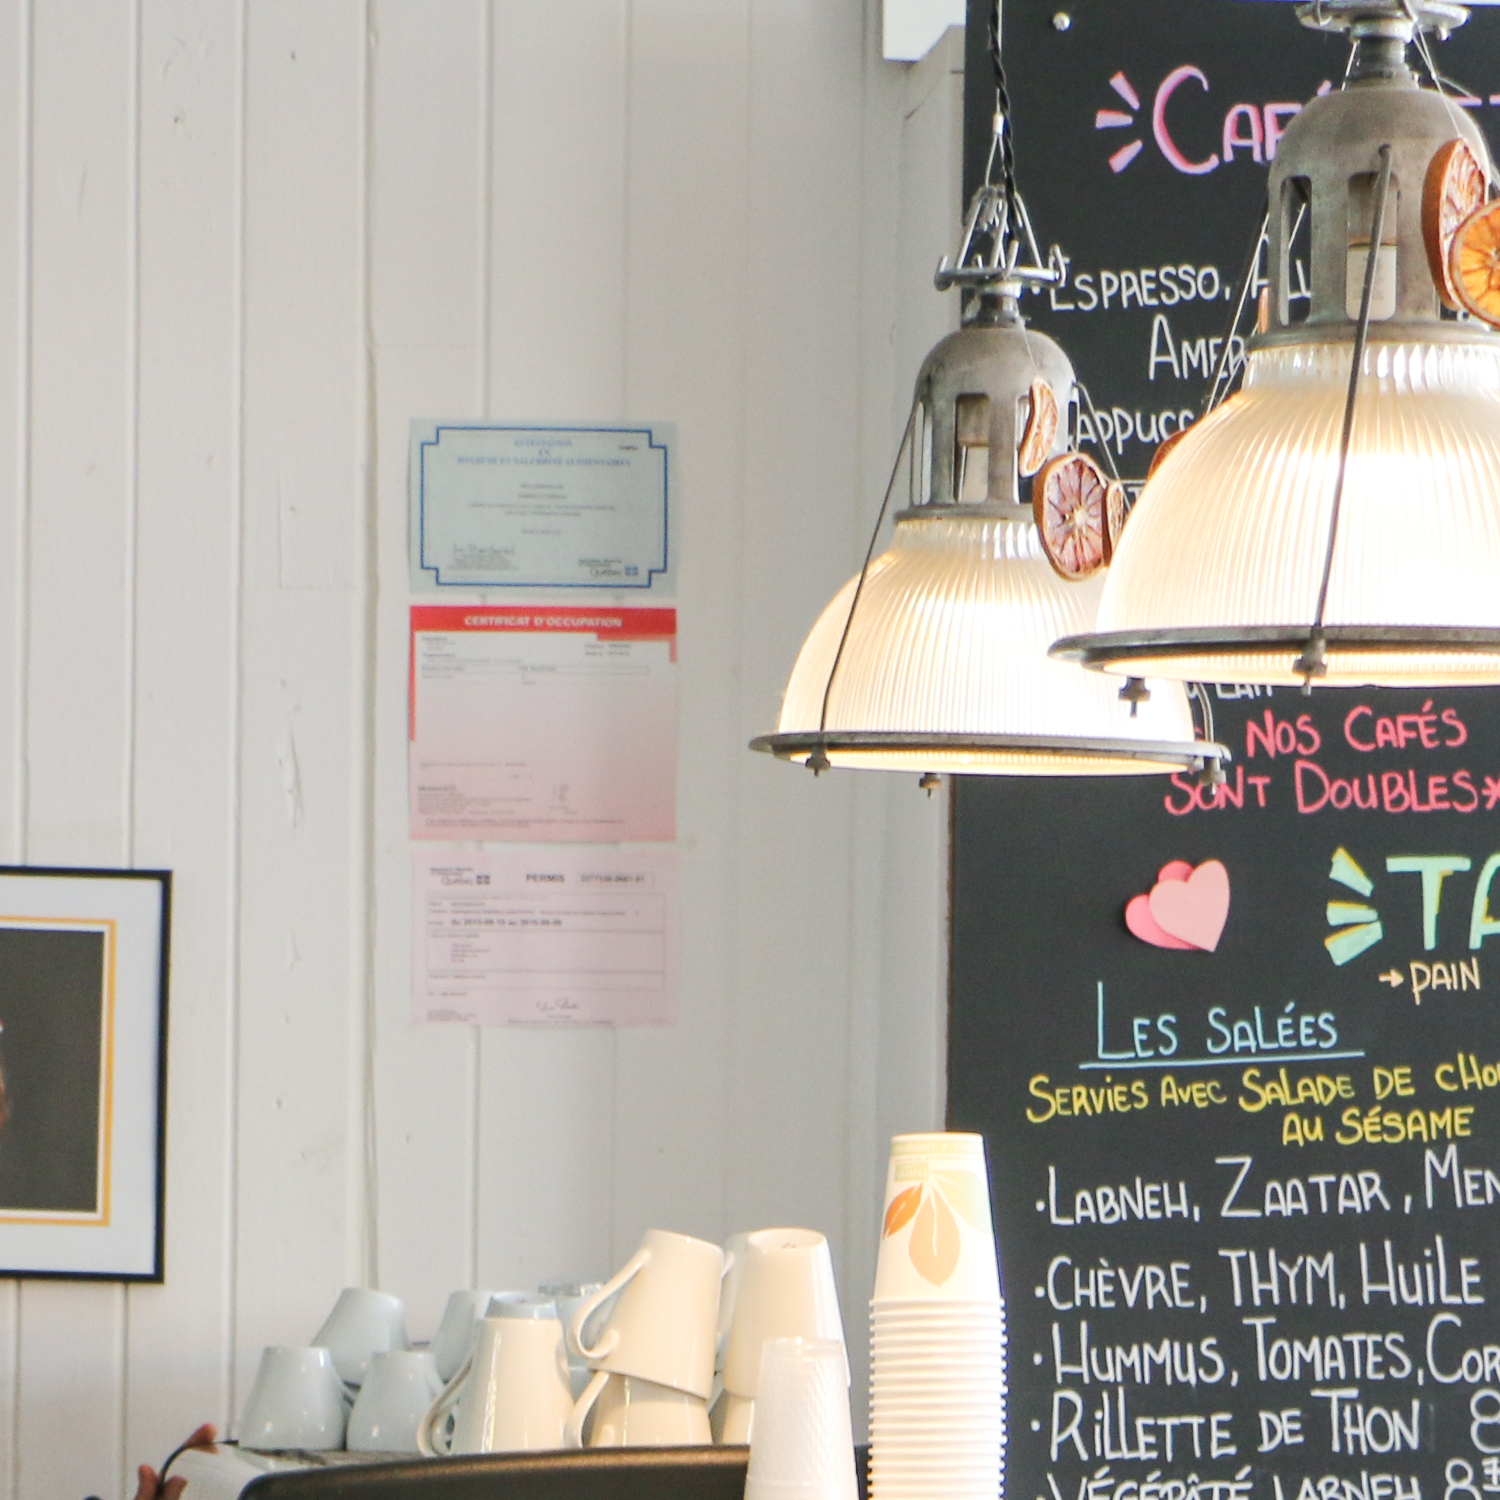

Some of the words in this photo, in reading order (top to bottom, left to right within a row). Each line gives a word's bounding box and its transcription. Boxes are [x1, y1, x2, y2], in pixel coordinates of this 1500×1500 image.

[1152, 64, 1332, 175] CAF
[1246, 708, 1322, 761] NOS
[1343, 699, 1468, 754] CAFÉS
[1410, 956, 1481, 1006] PAIN
[1097, 980, 1178, 1060] LES
[1206, 1001, 1339, 1055] SALÉES
[1160, 1073, 1228, 1110] AVEC
[1237, 1067, 1356, 1114] SALADE
[1373, 1064, 1416, 1101] DE
[1282, 1110, 1324, 1148] AU
[1335, 1105, 1476, 1147] SÉSAME
[1257, 1407, 1305, 1453] DE
[1310, 1387, 1420, 1456] THON
